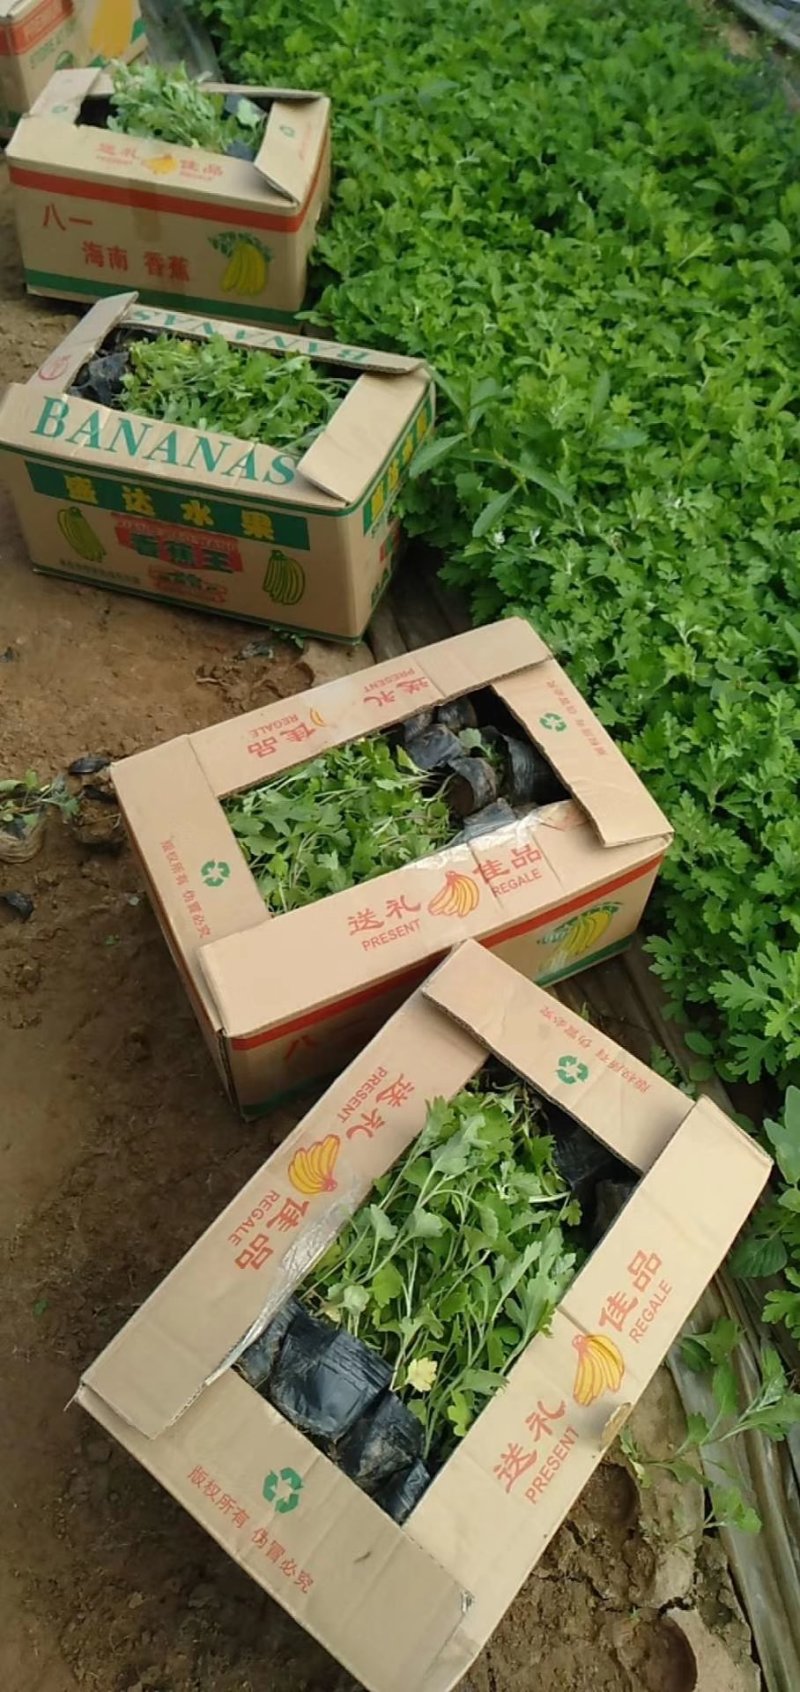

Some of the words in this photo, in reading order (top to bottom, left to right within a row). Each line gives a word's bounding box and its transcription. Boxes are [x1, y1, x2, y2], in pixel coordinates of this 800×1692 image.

[43, 203, 93, 231] 八一
[82, 240, 129, 271] 海南
[30, 396, 300, 486] BANANAS
[363, 676, 429, 707] 送礼
[248, 722, 315, 758] 佳品
[250, 713, 299, 737] REGALE
[348, 895, 421, 936] 送礼
[473, 843, 543, 884] 佳品
[361, 919, 421, 951] PRESENT
[491, 868, 542, 898] REGALE
[337, 1066, 387, 1123] PRESENT
[346, 1073, 415, 1140] 送礼
[228, 1190, 280, 1246] REGALE
[235, 1198, 310, 1270] 佳品
[493, 1399, 567, 1494] 送礼
[599, 1249, 663, 1332] 佳品
[525, 1426, 580, 1504] PRESENT
[629, 1279, 673, 1344] REGALE
[187, 1466, 250, 1528] 版权所有
